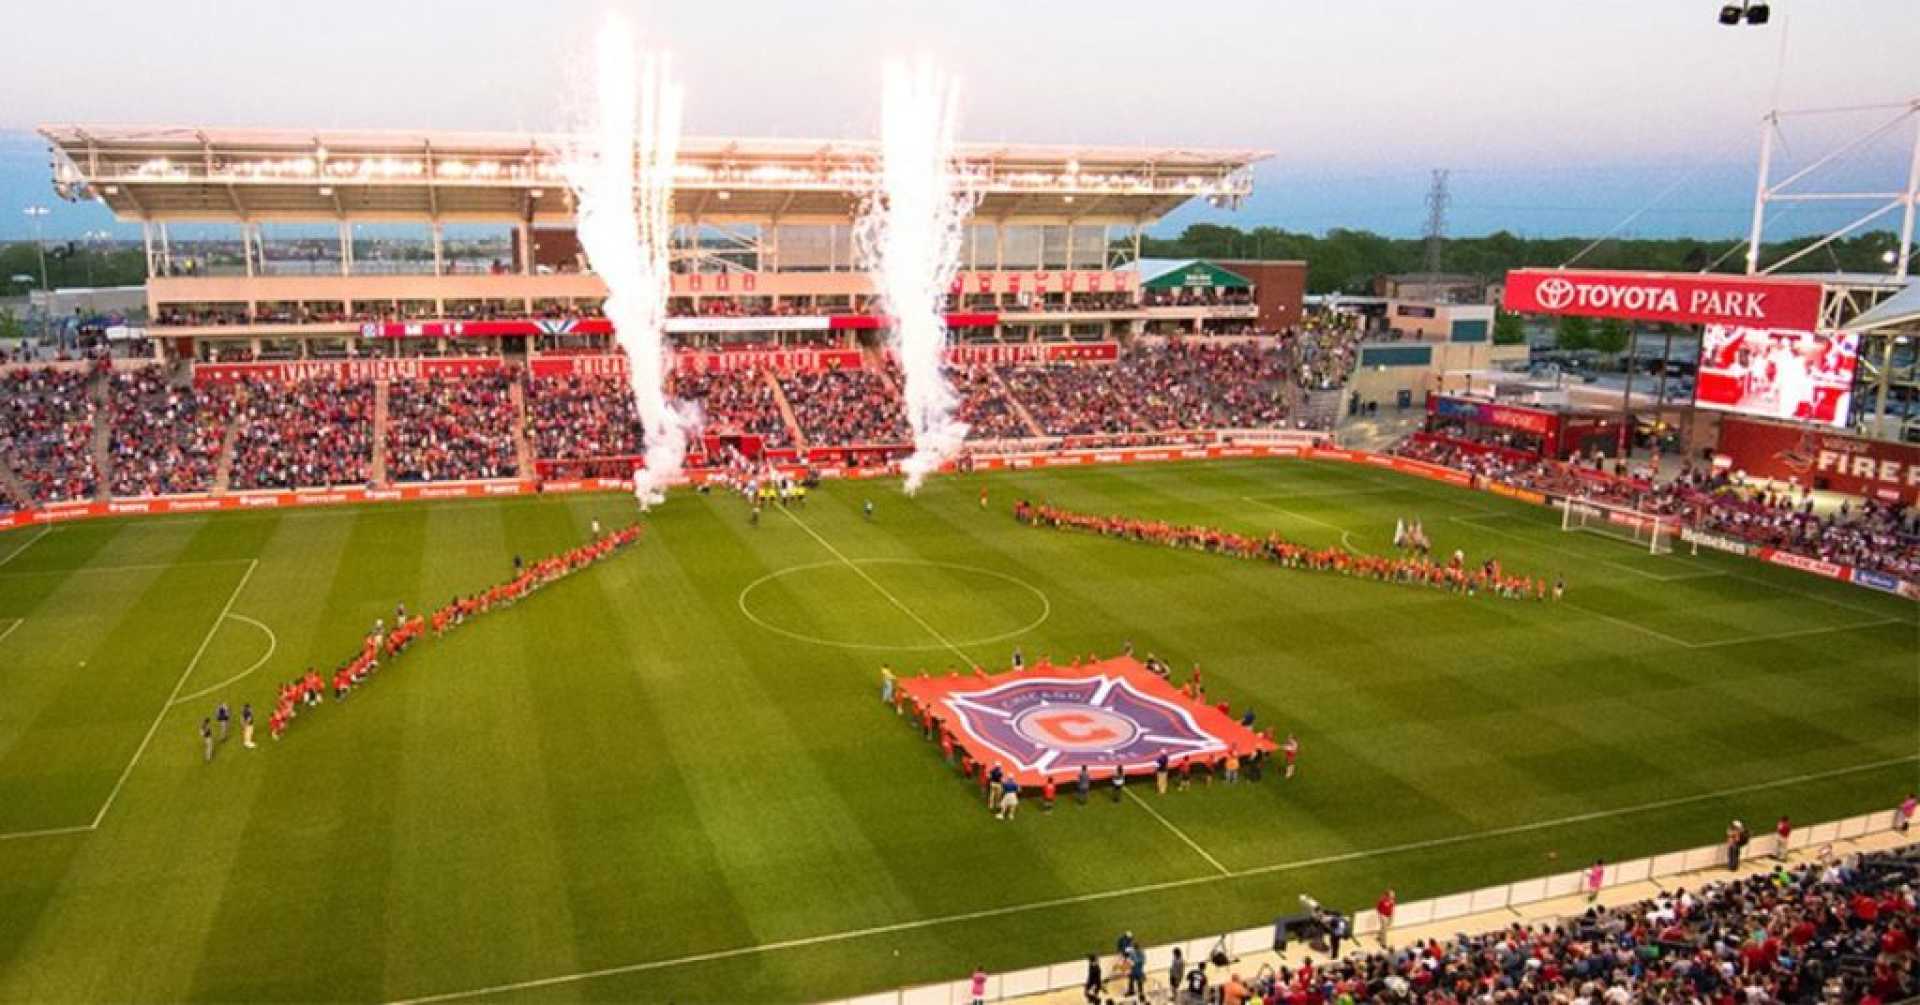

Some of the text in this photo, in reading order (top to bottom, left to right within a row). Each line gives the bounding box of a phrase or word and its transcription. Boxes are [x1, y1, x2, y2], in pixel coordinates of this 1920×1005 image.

[1575, 284, 1767, 318] TOYOTA PARK
[1817, 450, 1900, 483] FIRE
[1034, 714, 1118, 744] C
